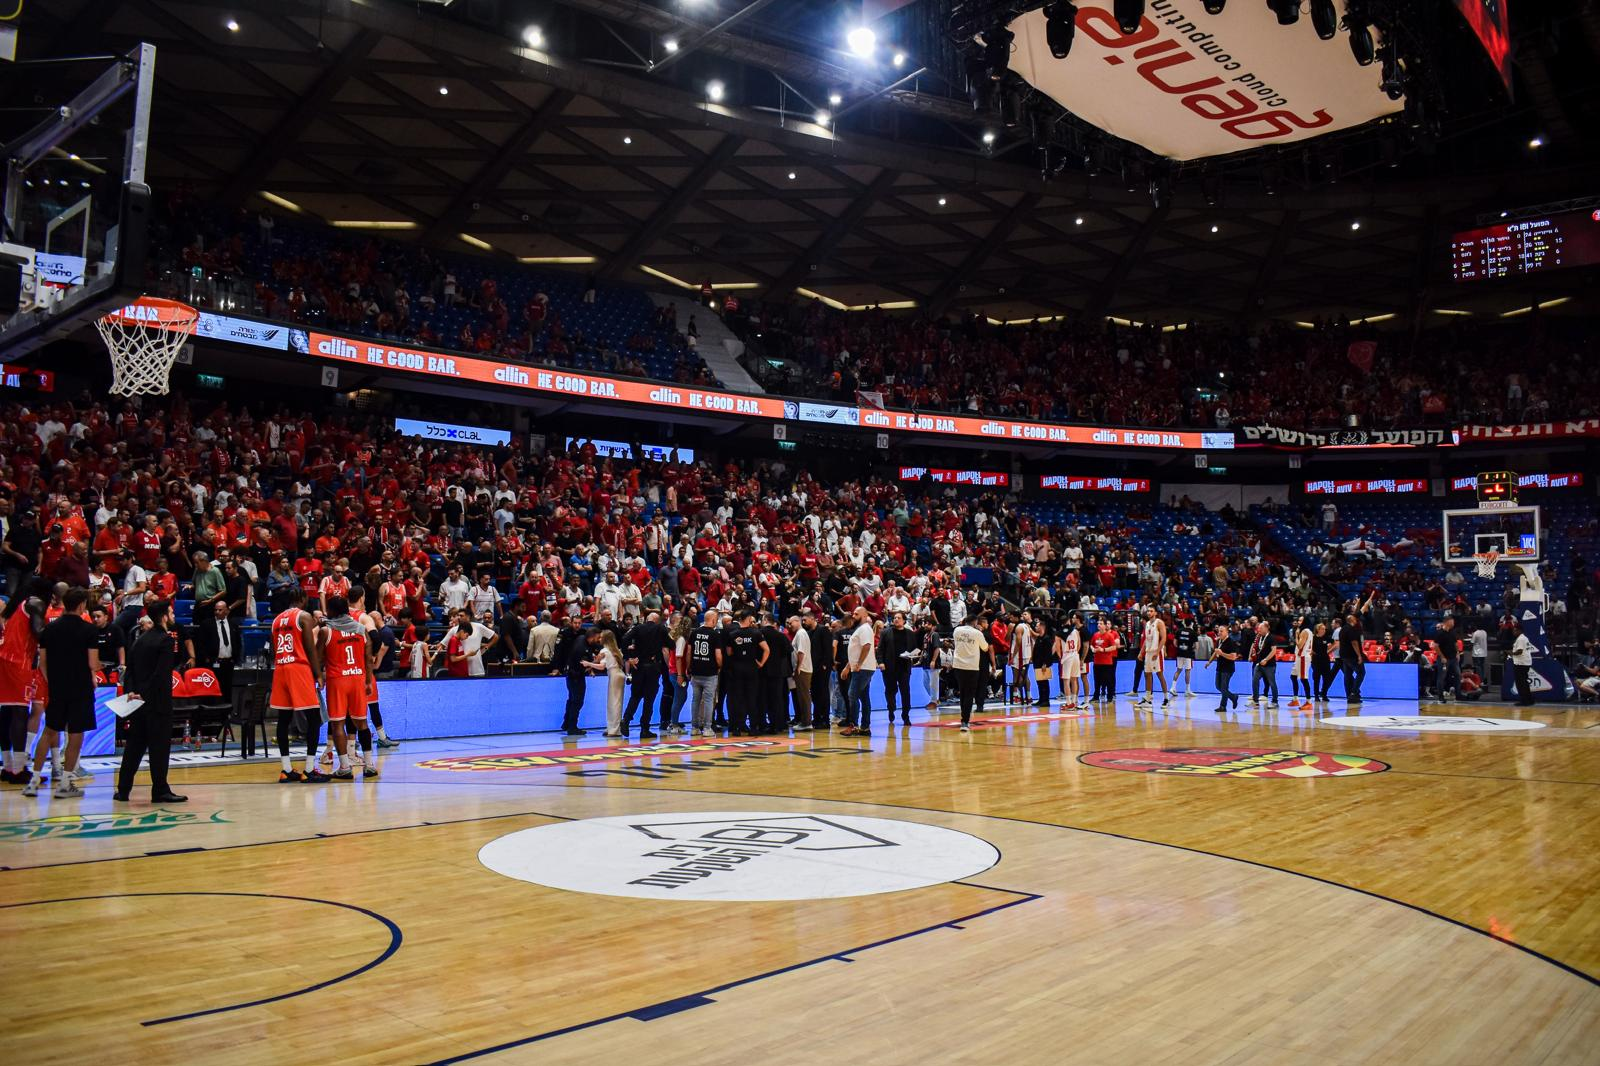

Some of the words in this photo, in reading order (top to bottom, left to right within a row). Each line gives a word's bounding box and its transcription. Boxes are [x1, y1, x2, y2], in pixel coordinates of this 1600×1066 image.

[1150, 0, 1241, 71] computin
[1074, 5, 1334, 140] genie
[1233, 73, 1288, 108] cloud
[1529, 220, 1550, 228] הפועל
[318, 339, 357, 358] allin
[367, 347, 384, 364] HE
[387, 350, 424, 371] GOOD
[428, 357, 460, 375] BAR.
[494, 366, 529, 385] allin
[537, 372, 552, 388] HE
[555, 375, 586, 393] GOOD
[590, 380, 619, 397] BAR.
[650, 388, 681, 404] allin
[689, 393, 703, 406] HE
[705, 396, 733, 411] GOOD
[736, 400, 762, 415] BAR.
[864, 411, 890, 426] allin
[896, 416, 907, 428] HE
[936, 419, 958, 432] BAR.
[427, 425, 446, 438] כלל
[981, 421, 1005, 435] allin
[1011, 425, 1022, 437] HE
[1024, 426, 1047, 439] GOOD
[1049, 428, 1070, 440] BAR.
[1092, 430, 1118, 442] allin
[1124, 432, 1135, 444] HE
[1137, 433, 1160, 445] GOOD
[1162, 435, 1184, 446] BAR.
[1243, 423, 1326, 446] ירושלים
[1371, 429, 1444, 445] הפועל
[878, 436, 888, 448] 10
[1195, 456, 1207, 467] 10
[983, 476, 996, 485] AVIV
[1070, 480, 1084, 489] AVIV
[1124, 482, 1138, 491] AVIV
[1336, 484, 1352, 493] AVIV
[1397, 483, 1413, 492] AVIV
[1454, 477, 1478, 489] HAPO
[1551, 477, 1568, 487] AVIV
[277, 634, 294, 653] 23
[1067, 639, 1075, 650] 13
[345, 646, 354, 664] 1
[342, 667, 362, 676] arkia
[0, 812, 198, 838] Sprite
[689, 824, 821, 848] IBI
[642, 844, 717, 860] בית
[627, 848, 769, 889] השקעות
